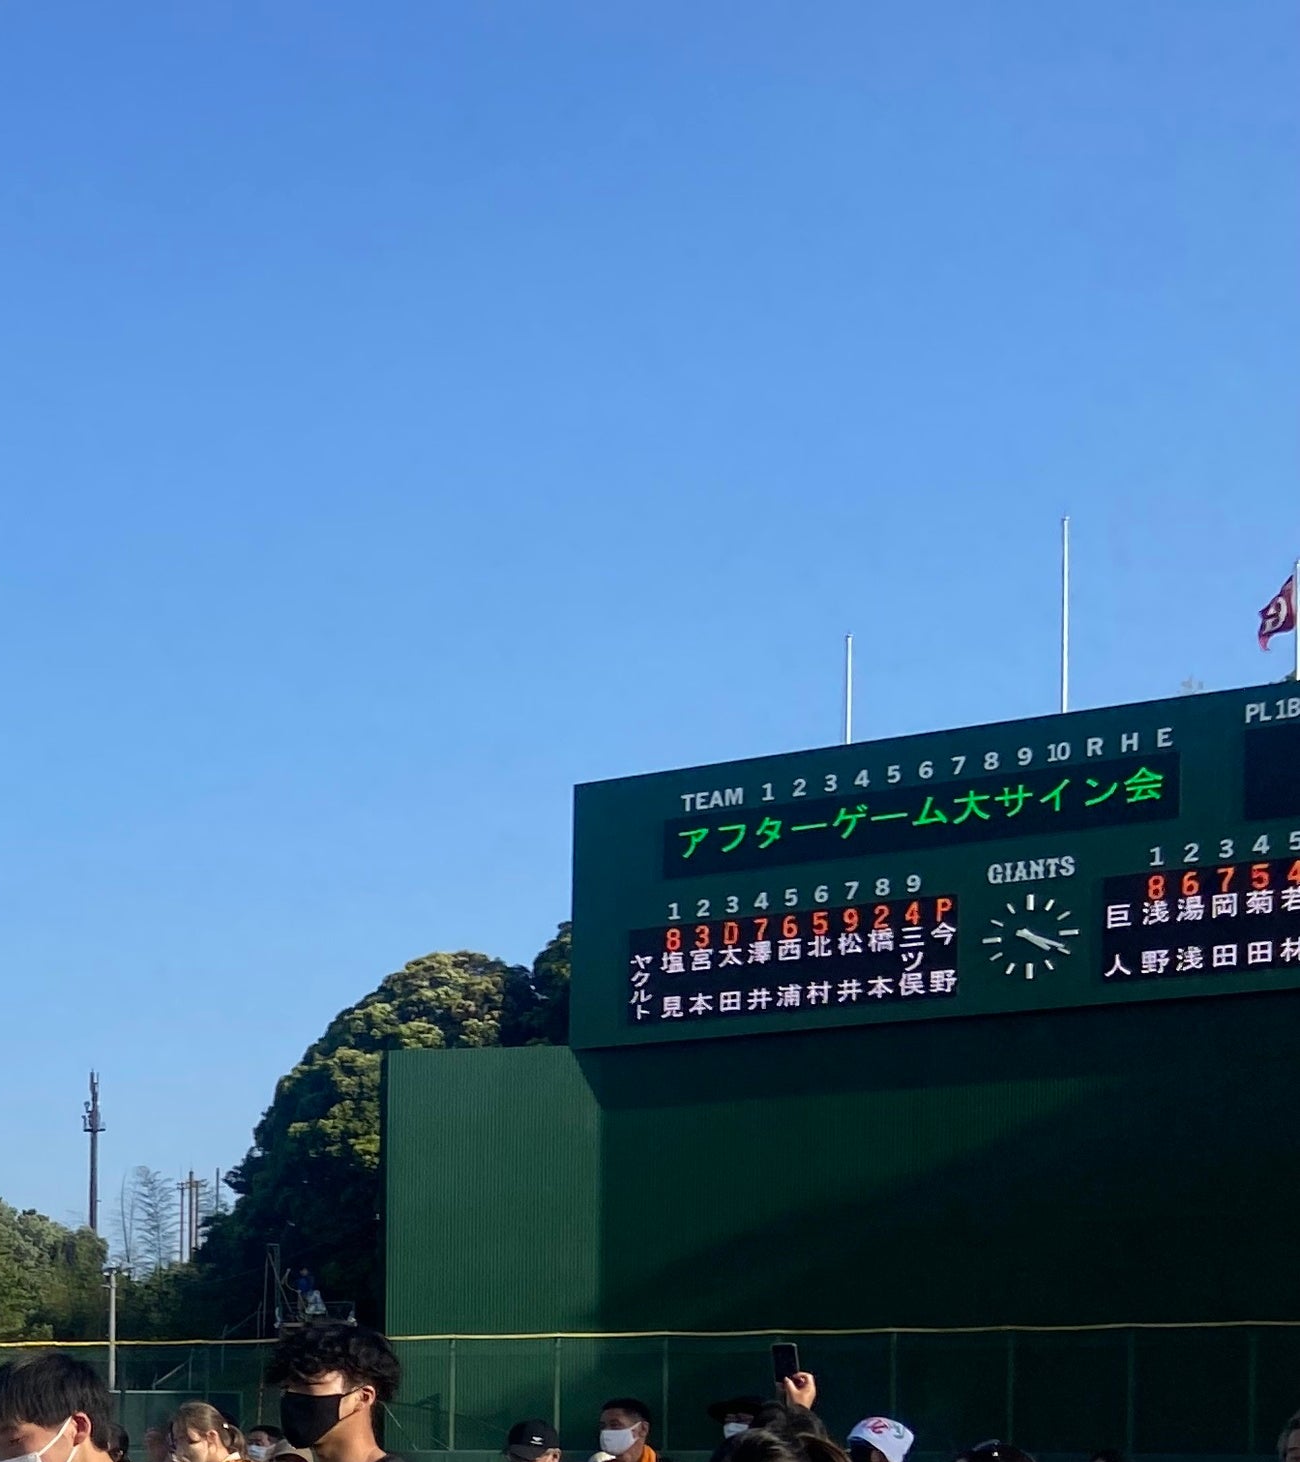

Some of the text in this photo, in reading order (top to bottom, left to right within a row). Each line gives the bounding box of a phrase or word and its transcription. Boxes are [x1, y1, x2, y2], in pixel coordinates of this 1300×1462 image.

[1245, 702, 1272, 723] PL
[680, 727, 1174, 812] TEAM 1 2 3 4 5 6 7 8 9 10 R H E
[678, 766, 1164, 858] アフターゲーム大サイン会
[987, 855, 1076, 884] GIANTS
[1148, 859, 1300, 900] 8 6 7 5 4
[1149, 830, 1300, 867] 1 2 3 4 5
[666, 928, 681, 951] 8
[695, 925, 710, 948] 3
[753, 918, 768, 940] 7
[782, 915, 798, 938] 6
[812, 911, 828, 935] 5
[843, 908, 859, 932] 9
[874, 905, 890, 928] 2
[905, 901, 920, 925] 4
[936, 898, 952, 922] P
[667, 874, 921, 920] 1 2 3 4 5 6 7 8 9
[1211, 892, 1238, 968] 岡田
[1245, 889, 1274, 965] 菊田
[837, 932, 863, 1002] 松井
[867, 928, 895, 999] 橋本
[898, 926, 926, 997] 三ツ俣
[929, 921, 957, 993] 今野
[1104, 903, 1132, 977] 巨人
[1140, 899, 1170, 975] 浅野
[1175, 895, 1205, 972] 湯浅
[629, 954, 653, 1020] ヤクルト
[660, 951, 686, 1019] 塩見
[689, 948, 714, 1015] 宮本
[718, 944, 744, 1012] 太田
[747, 940, 773, 1010] 澤井
[776, 938, 802, 1007] 西浦
[807, 936, 832, 1005] 北村
